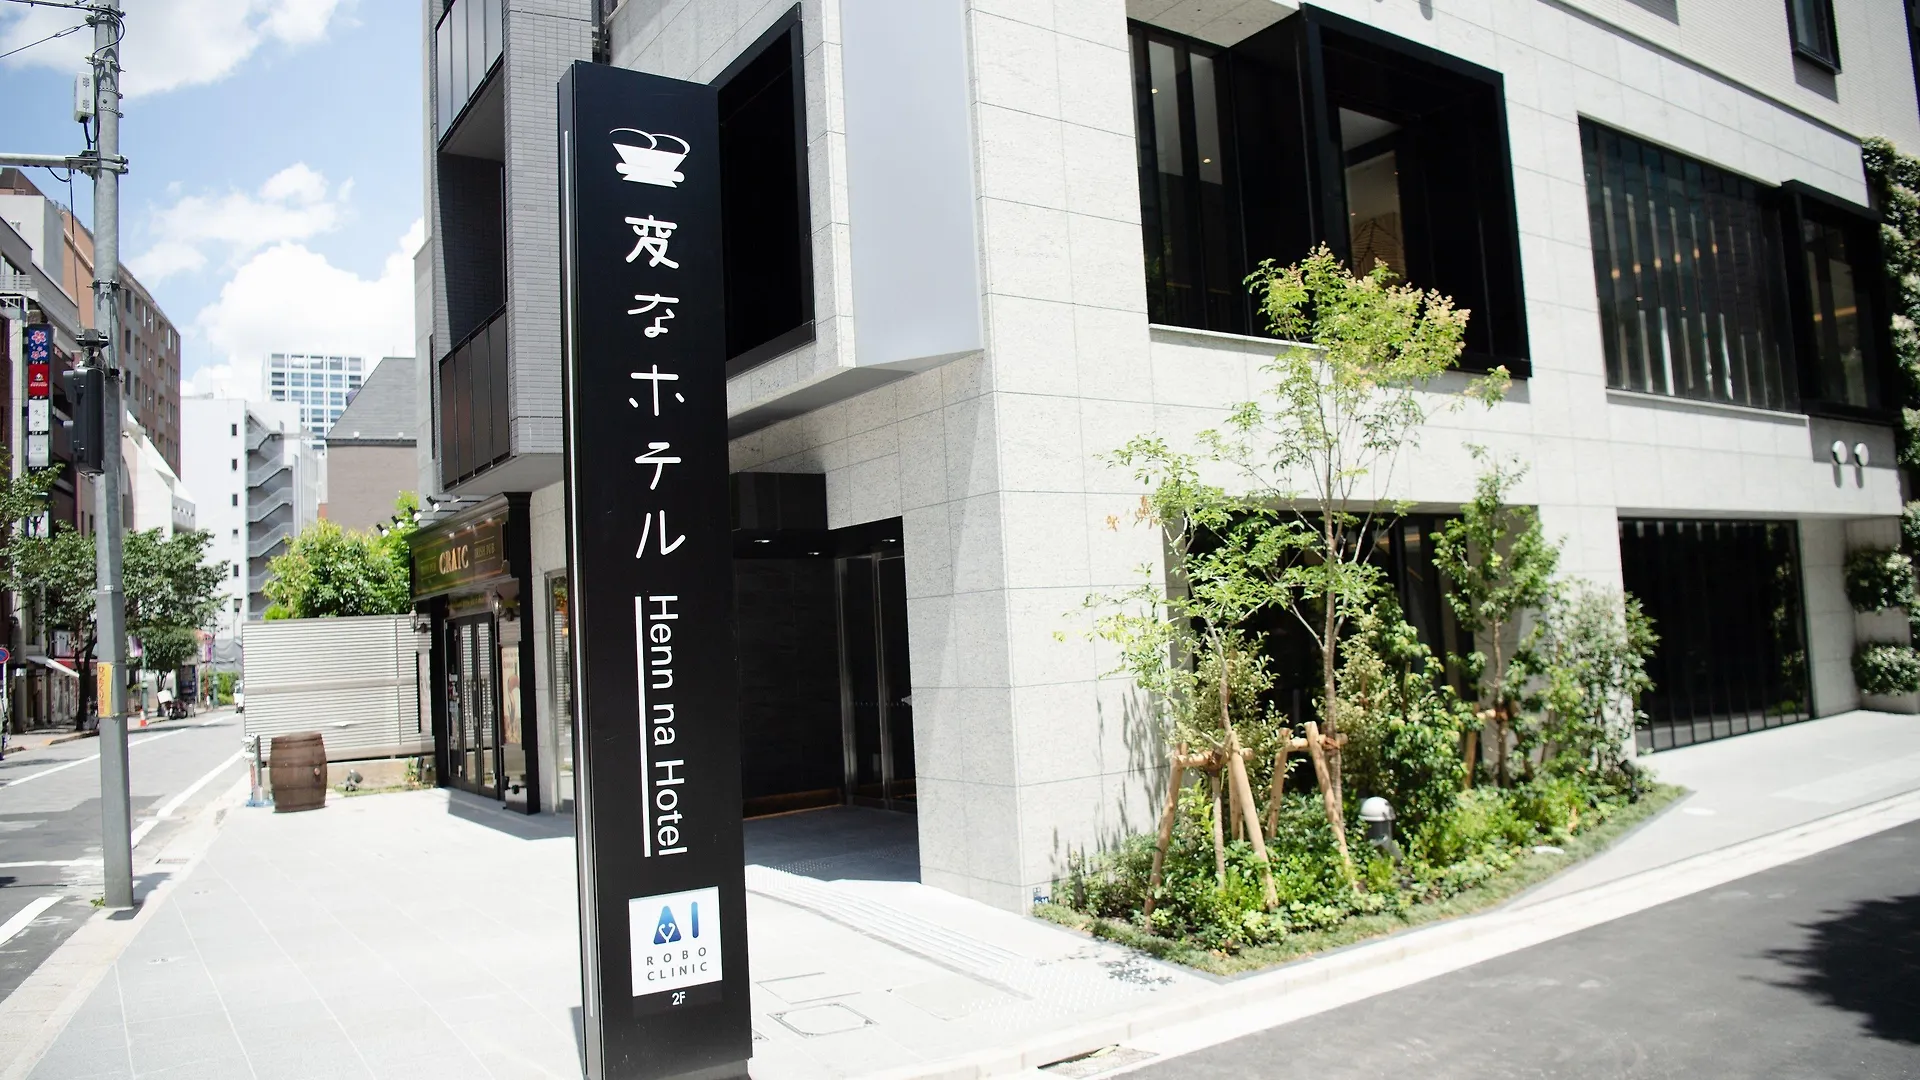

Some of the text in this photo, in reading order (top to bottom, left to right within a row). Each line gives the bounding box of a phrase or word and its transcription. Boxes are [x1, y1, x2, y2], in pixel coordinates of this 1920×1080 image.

[625, 214, 686, 559] 変なホテル
[439, 544, 469, 575] CRAIC
[649, 595, 688, 856] Henn na Hotel
[653, 901, 700, 945] AI
[646, 946, 707, 966] ROBO
[647, 961, 708, 981] CLINIC
[671, 990, 686, 1006] 2F
